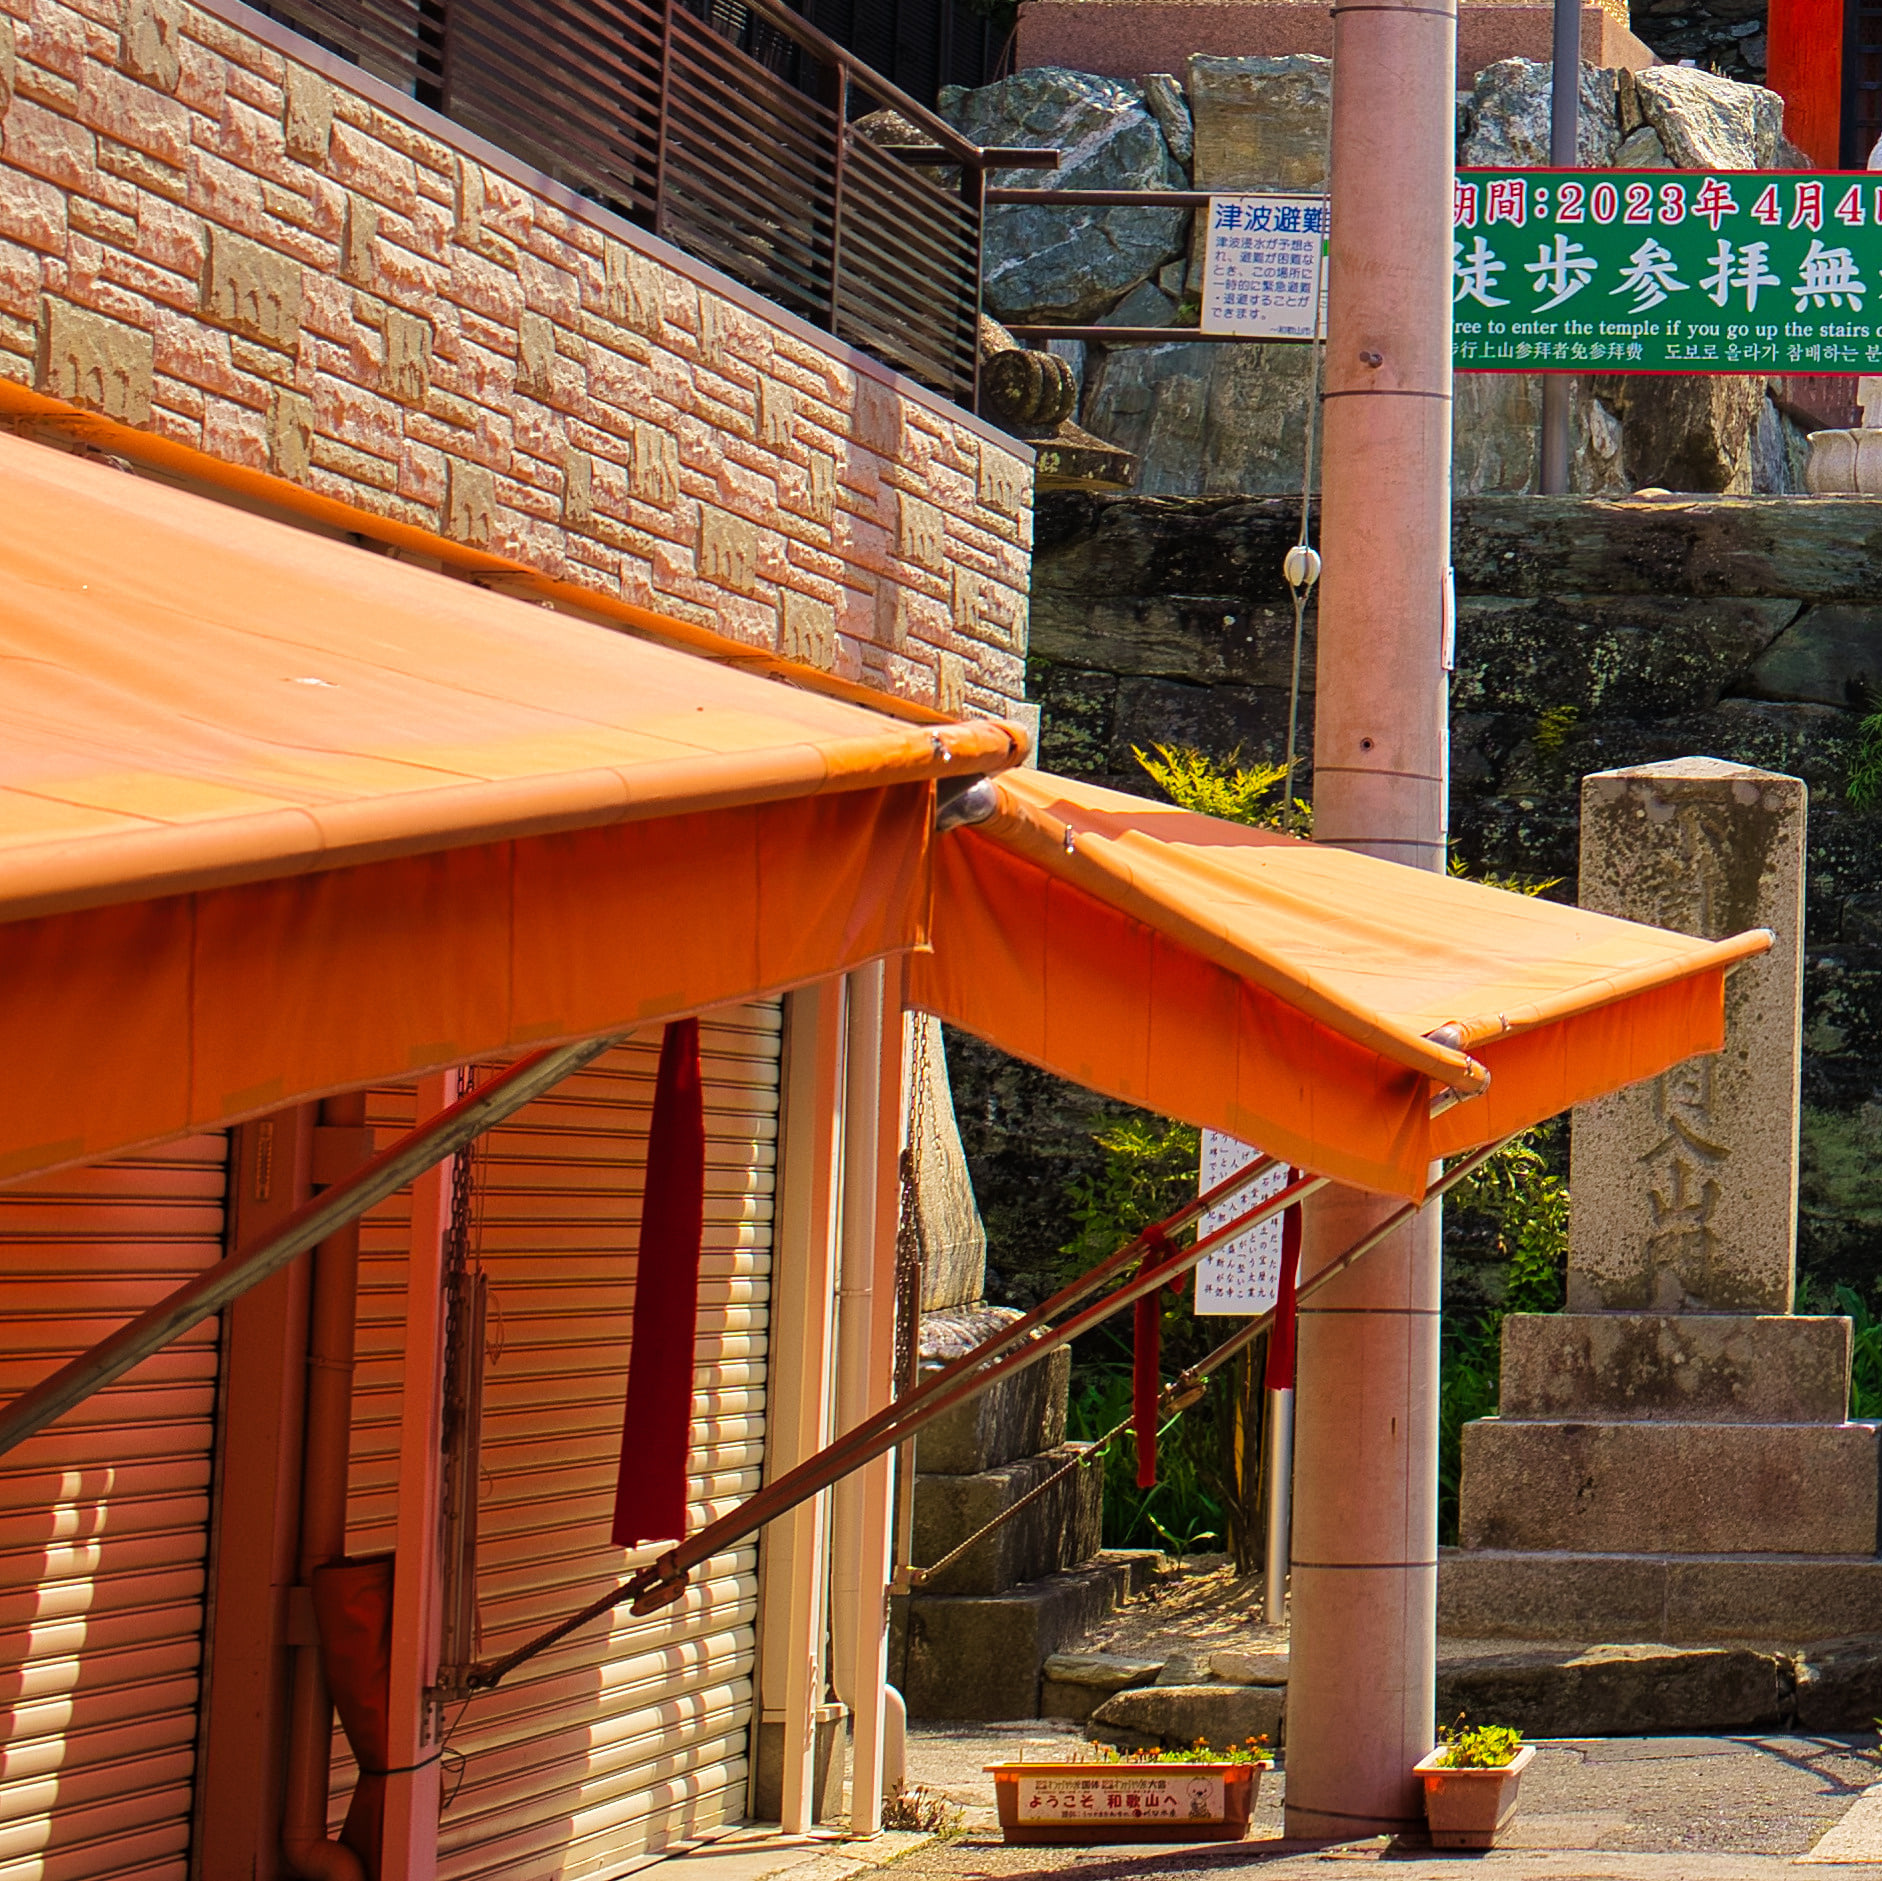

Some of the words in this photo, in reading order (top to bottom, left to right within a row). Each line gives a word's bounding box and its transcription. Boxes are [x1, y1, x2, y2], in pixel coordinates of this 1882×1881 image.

[1212, 308, 1267, 321] できます。
[1453, 322, 1481, 336] ree
[1488, 323, 1506, 336] to
[1511, 323, 1558, 337] enter
[1564, 321, 1594, 337] the
[1599, 321, 1660, 342] temple
[1666, 320, 1681, 337] if
[1687, 324, 1720, 342] you
[1726, 325, 1749, 343] go
[1755, 325, 1777, 343] up
[1784, 322, 1813, 338] the
[1819, 322, 1870, 339] stairs
[1664, 344, 1719, 360] 도보로
[1724, 343, 1780, 362] 올라가
[1786, 344, 1859, 363] 참배하는
[1029, 1794, 1094, 1810] ようこそ
[1107, 1792, 1178, 1810] 和歌山へ
